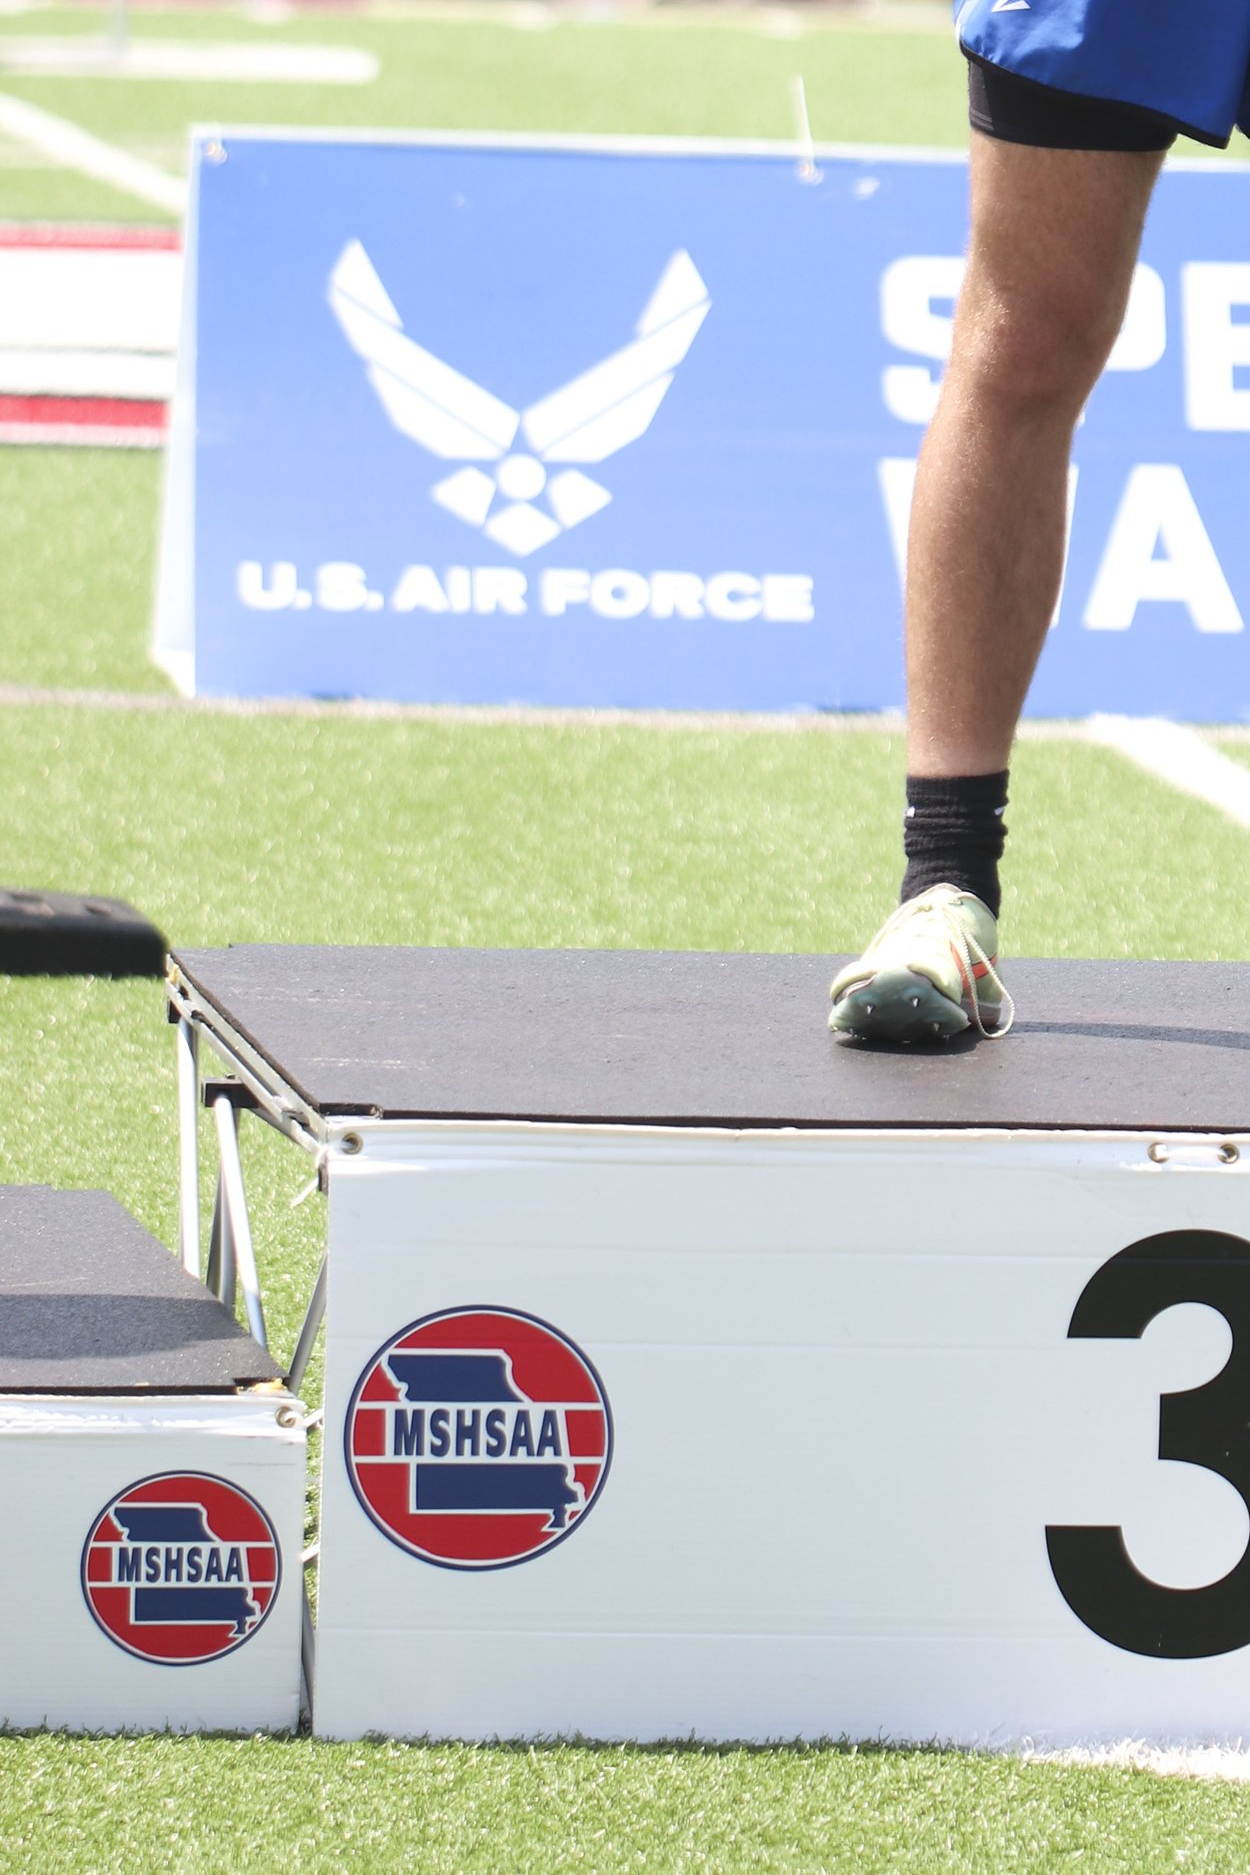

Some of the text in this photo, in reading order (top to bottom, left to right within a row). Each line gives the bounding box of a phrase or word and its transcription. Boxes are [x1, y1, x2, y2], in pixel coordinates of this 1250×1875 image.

[237, 560, 815, 622] U.S. AIR FORCE
[393, 1408, 563, 1457] MSHSAA
[117, 1546, 244, 1584] MSHSAA
